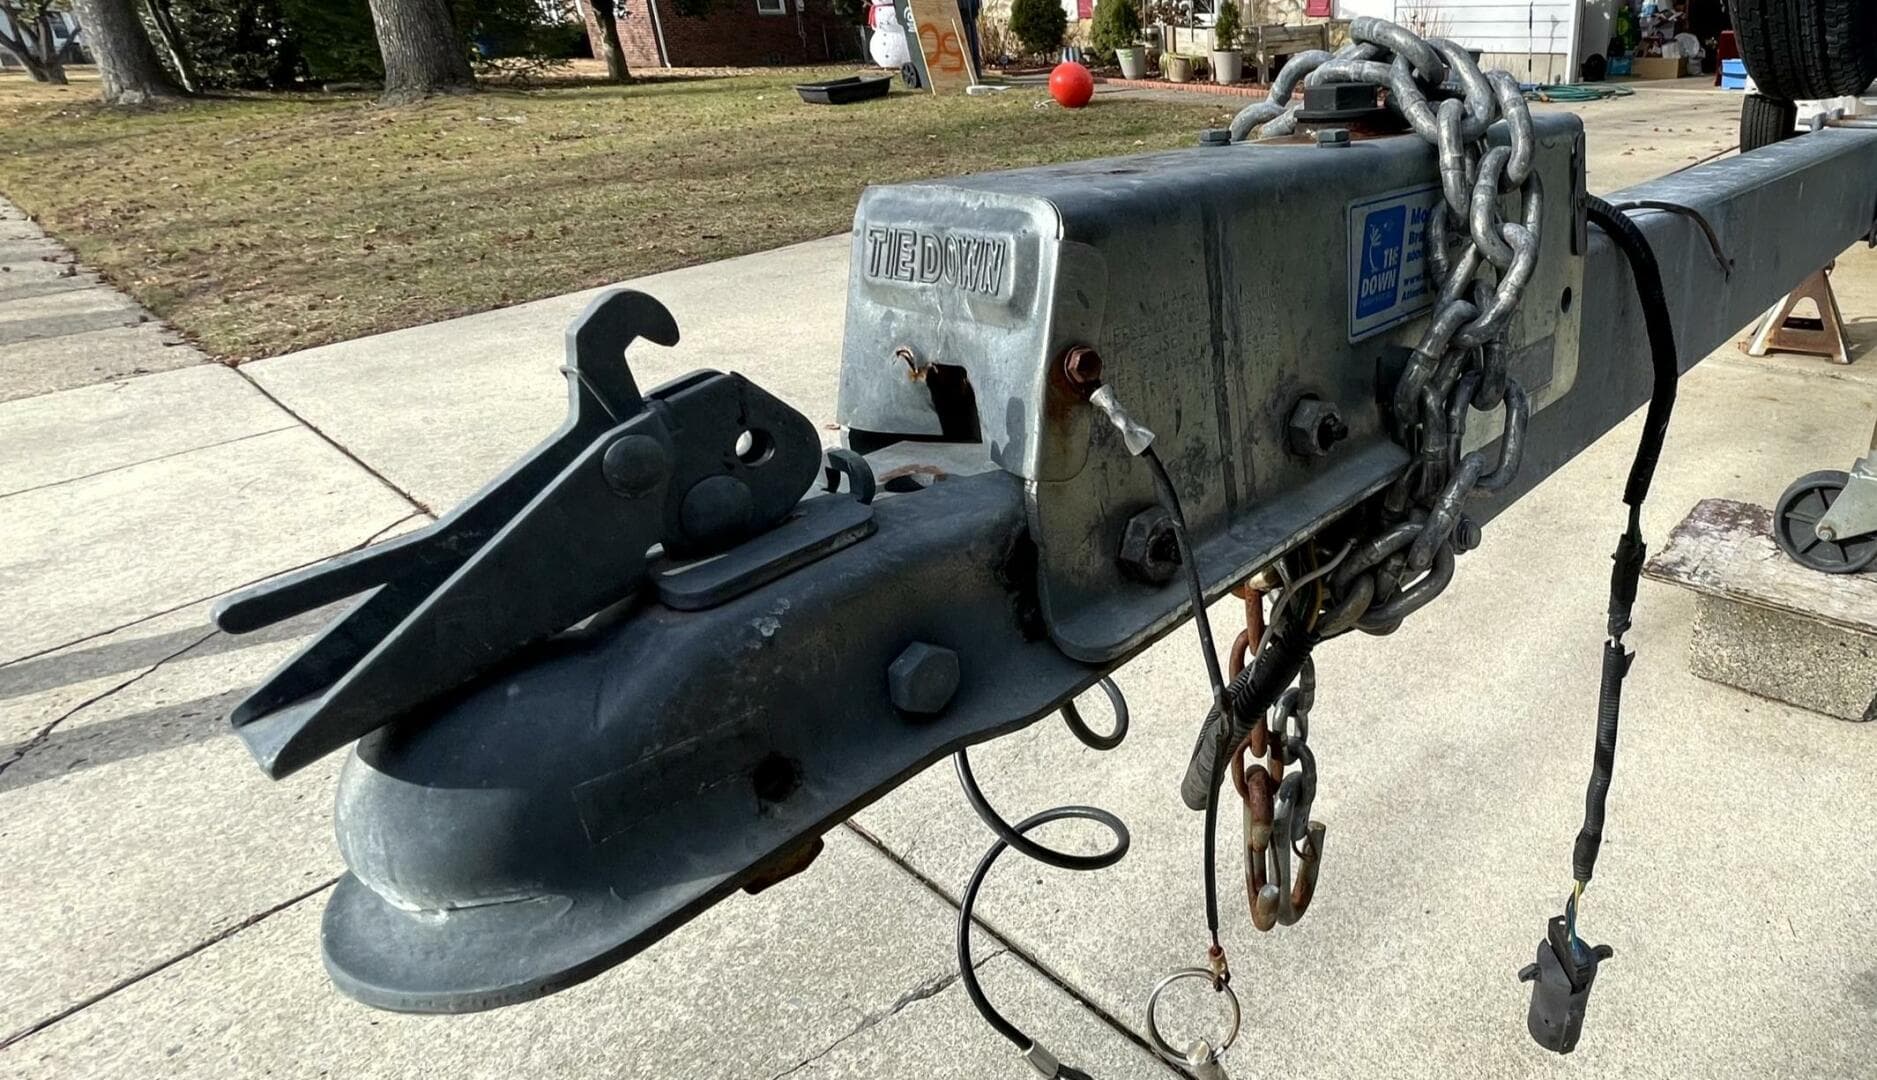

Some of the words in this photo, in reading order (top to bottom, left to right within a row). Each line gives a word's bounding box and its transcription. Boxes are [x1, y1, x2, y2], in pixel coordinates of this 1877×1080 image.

[869, 225, 917, 282] TIE
[919, 232, 1007, 297] DOWN
[1383, 246, 1399, 269] TIE
[1361, 269, 1397, 299] DOWN
